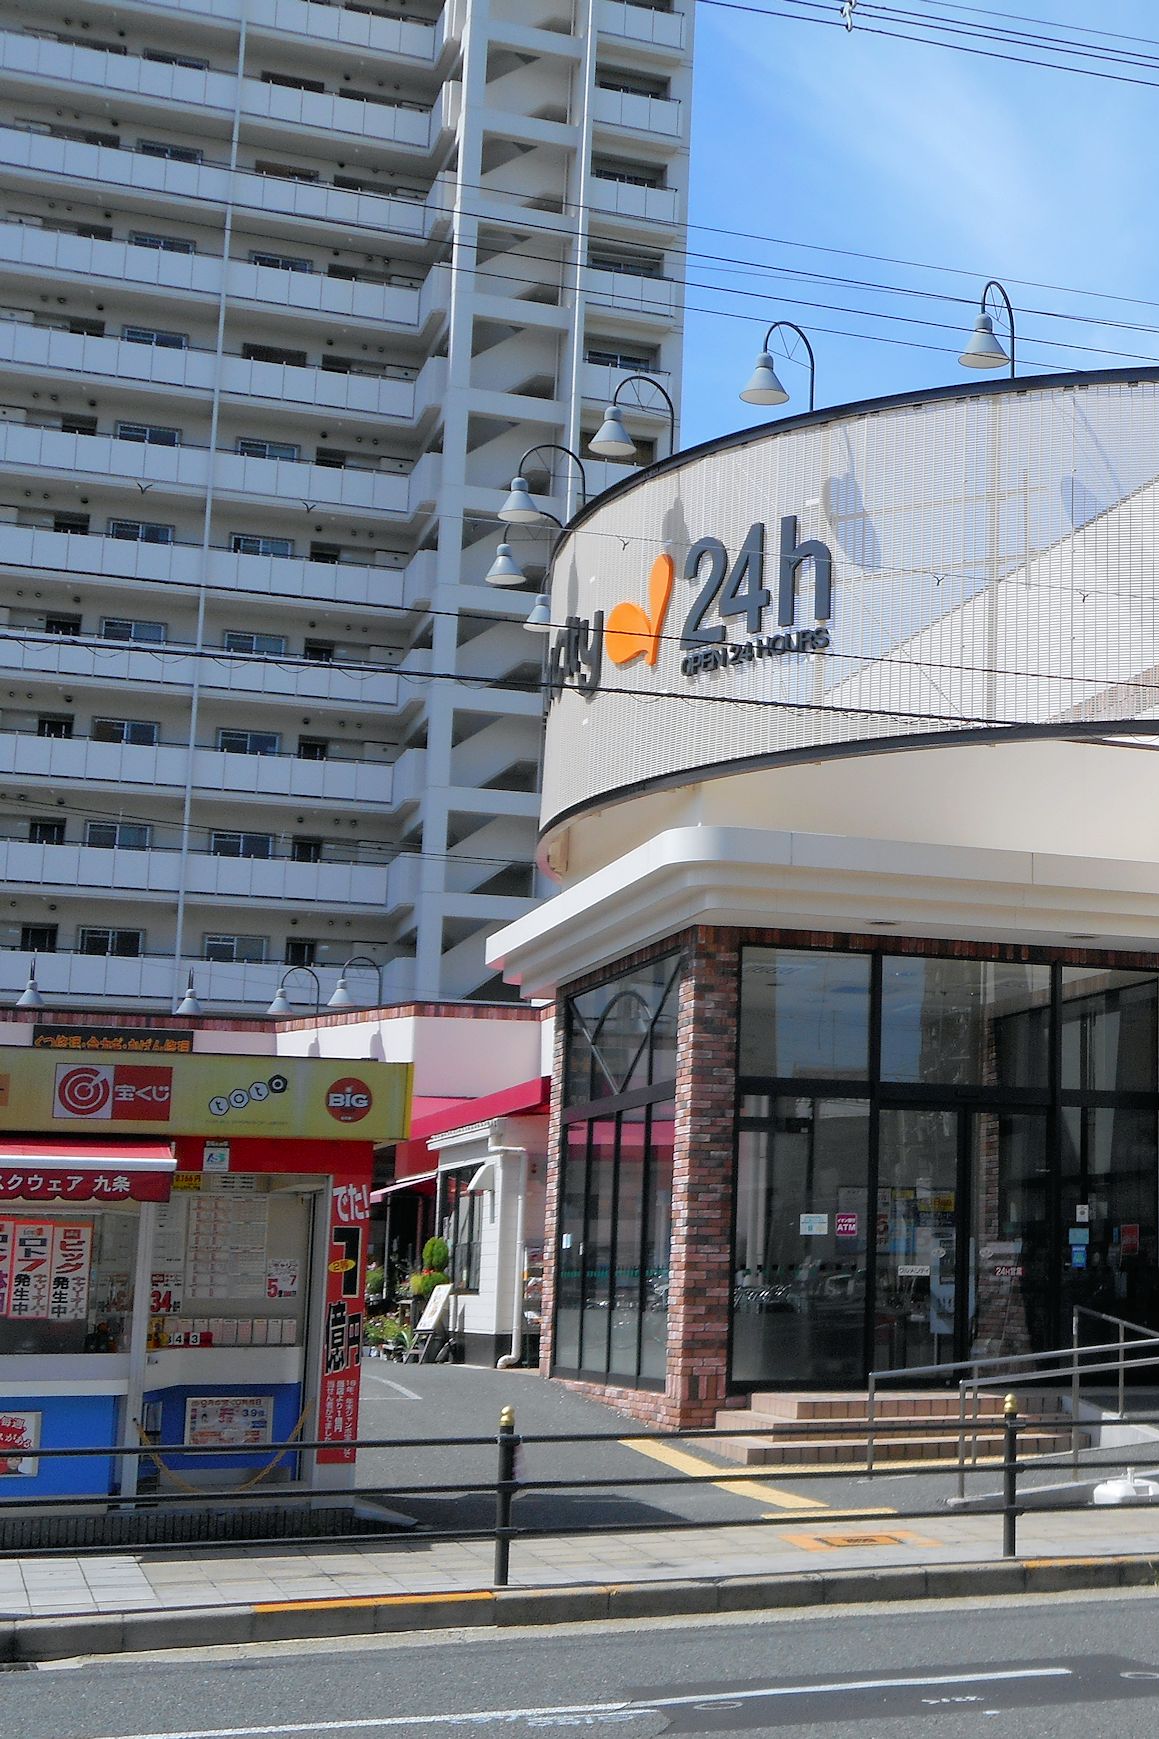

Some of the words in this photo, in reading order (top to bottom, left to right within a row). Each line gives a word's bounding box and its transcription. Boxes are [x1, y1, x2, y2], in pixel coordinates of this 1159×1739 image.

[680, 515, 831, 650] 24h
[681, 648, 728, 677] OPEN
[728, 641, 754, 666] 24
[756, 627, 831, 659] HOURS
[115, 1085, 170, 1102] 宝くじ
[210, 1074, 287, 1114] toto
[327, 1088, 369, 1108] BIG
[93, 1175, 131, 1193] 九条
[837, 1223, 856, 1231] ATM
[12, 1274, 31, 1316] 発生中
[51, 1277, 70, 1318] 発生中
